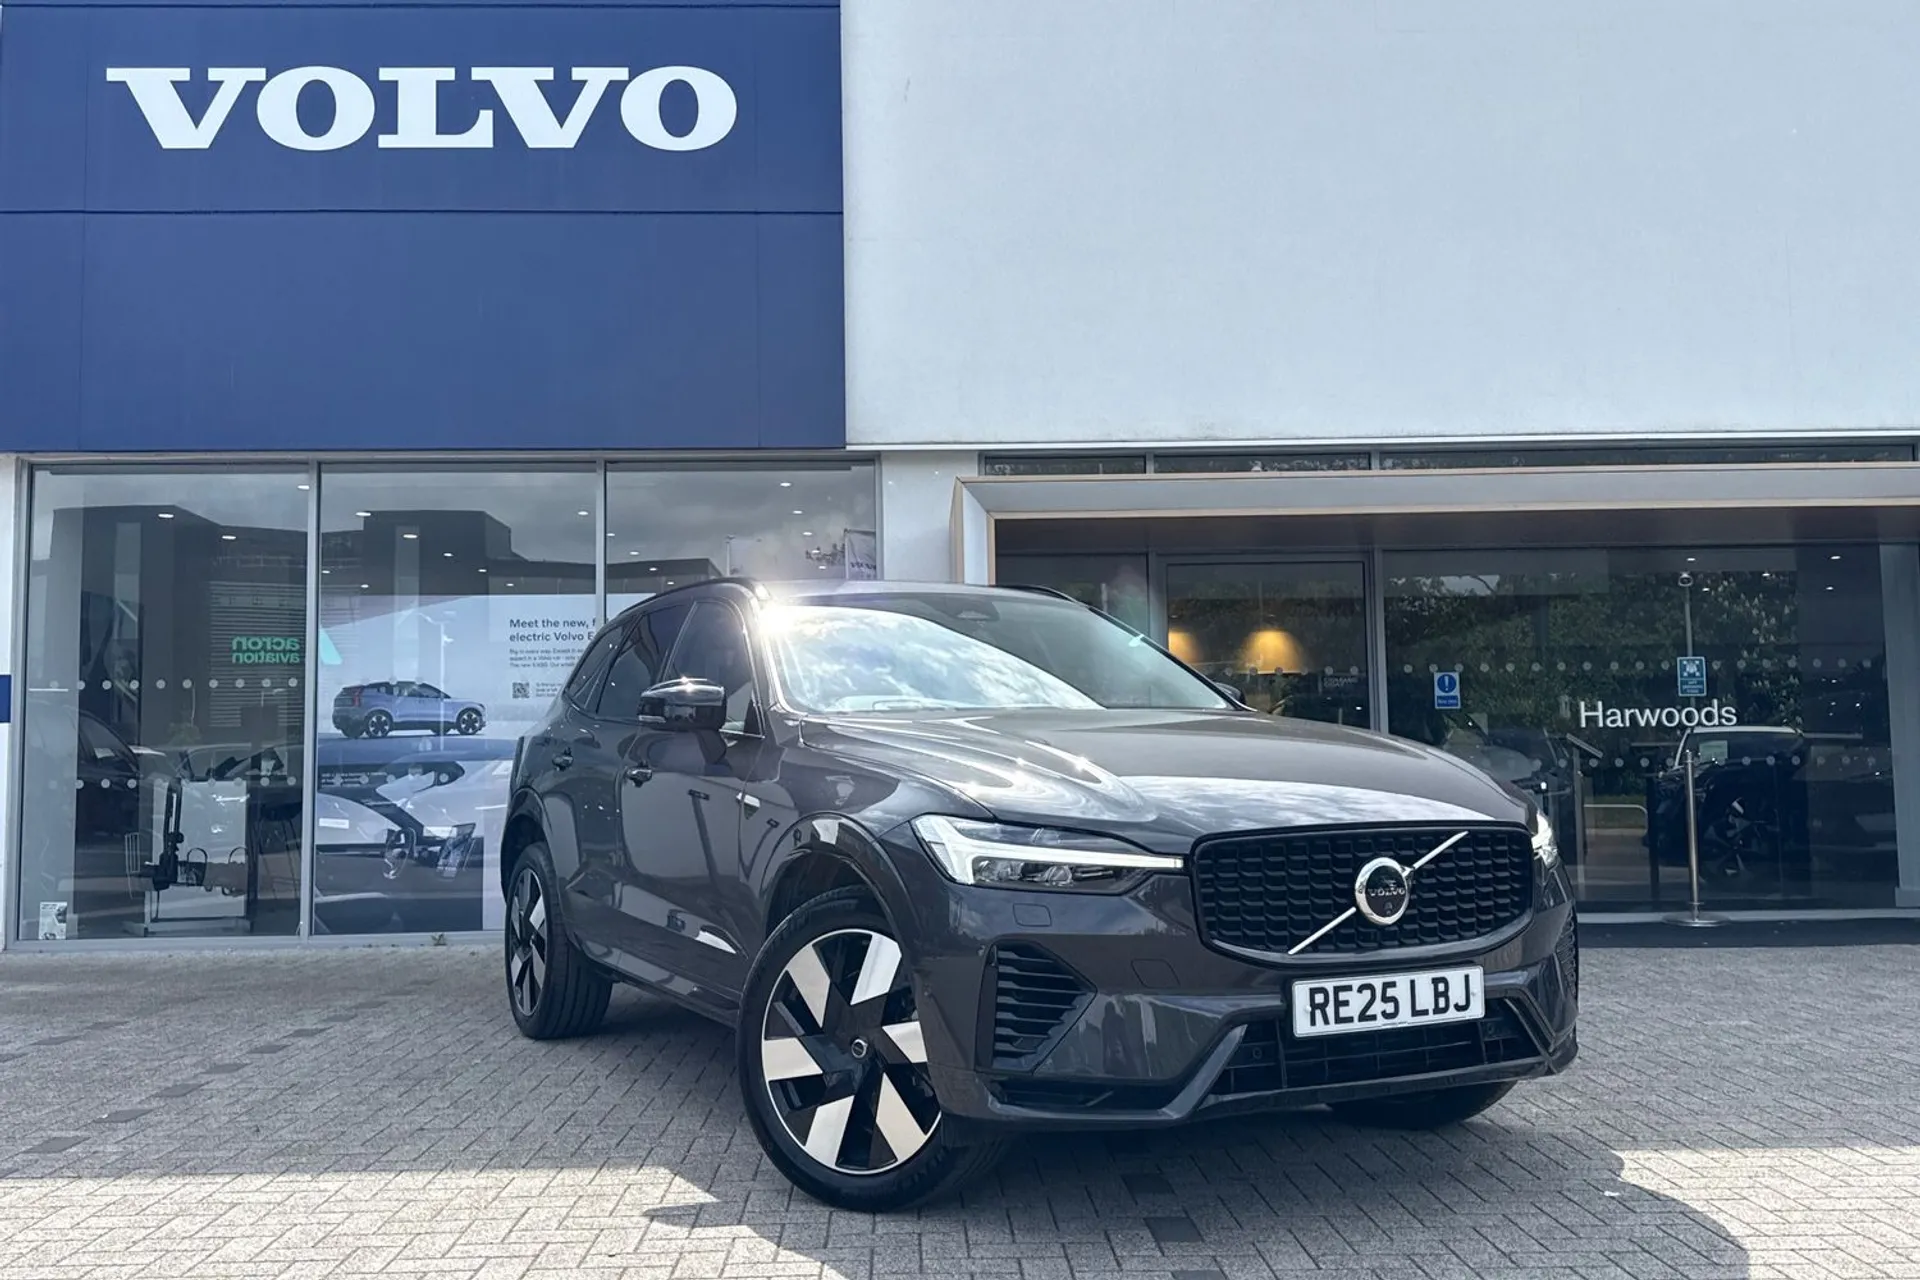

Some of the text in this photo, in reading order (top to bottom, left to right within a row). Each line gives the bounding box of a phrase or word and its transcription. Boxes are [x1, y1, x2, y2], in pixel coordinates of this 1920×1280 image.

[106, 66, 738, 151] VOLVO
[509, 619, 539, 628] Meet
[541, 619, 560, 628] the
[562, 620, 589, 629] new,
[509, 632, 551, 642] electric
[553, 632, 584, 641] Volvo
[1579, 699, 1738, 728] Harwoods
[1368, 887, 1406, 897] VOLVO
[1308, 973, 1471, 1027] RE25 LBJ
